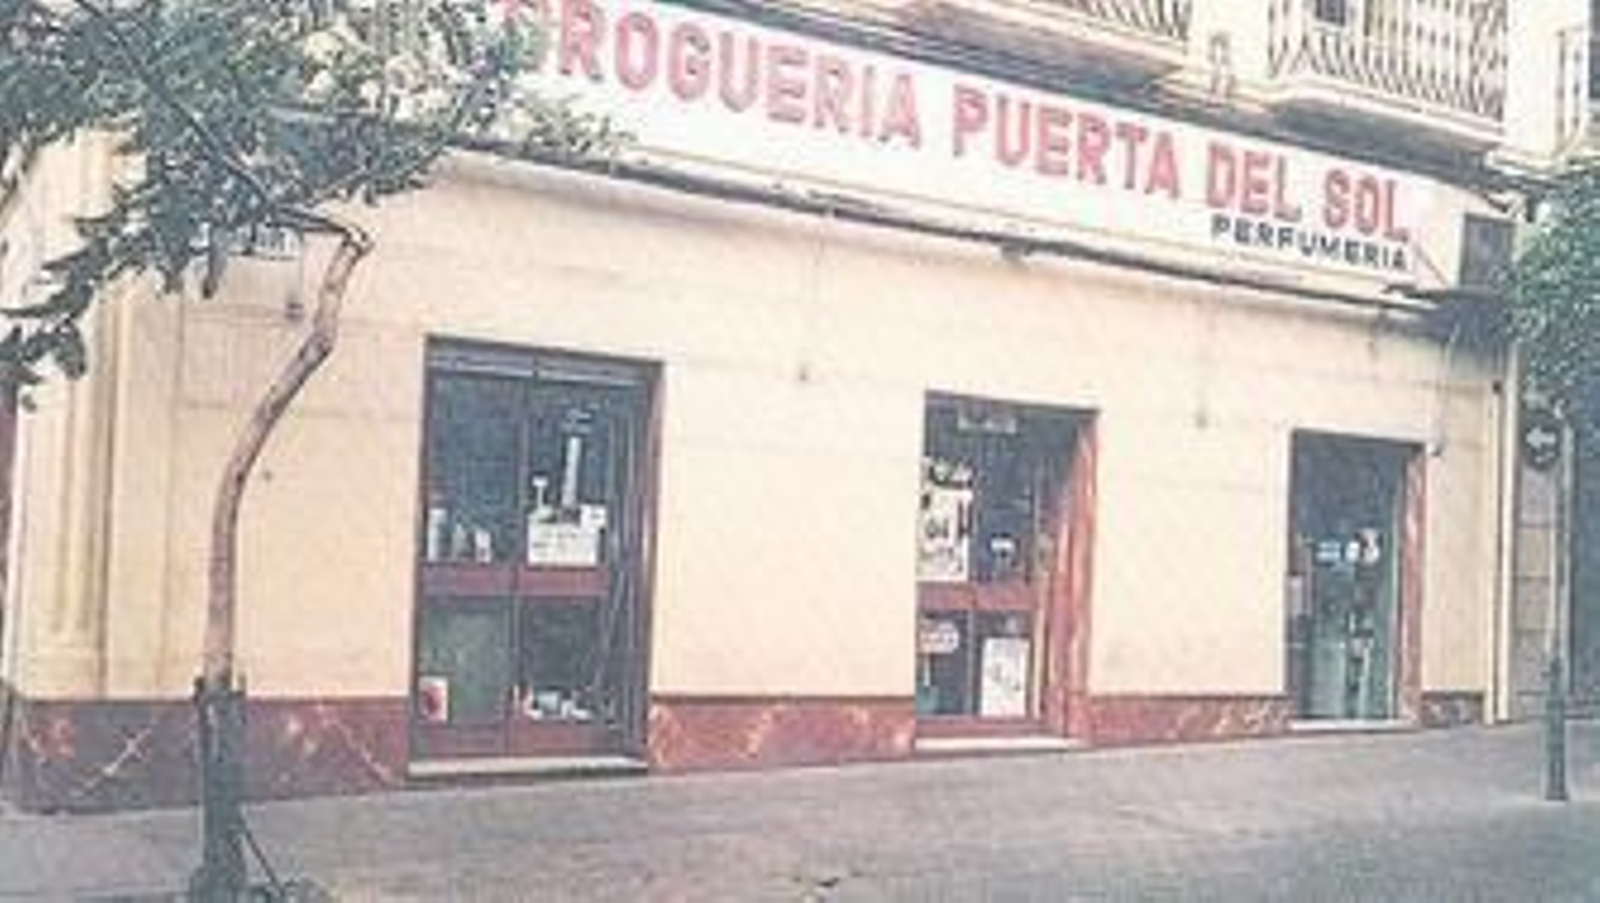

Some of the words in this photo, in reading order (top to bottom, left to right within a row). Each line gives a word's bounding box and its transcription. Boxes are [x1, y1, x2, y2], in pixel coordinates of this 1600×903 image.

[953, 85, 1179, 199] PUERTA
[1206, 143, 1302, 222] DEL
[1324, 169, 1409, 243] SOL
[1211, 214, 1409, 270] PERFUMERIA
